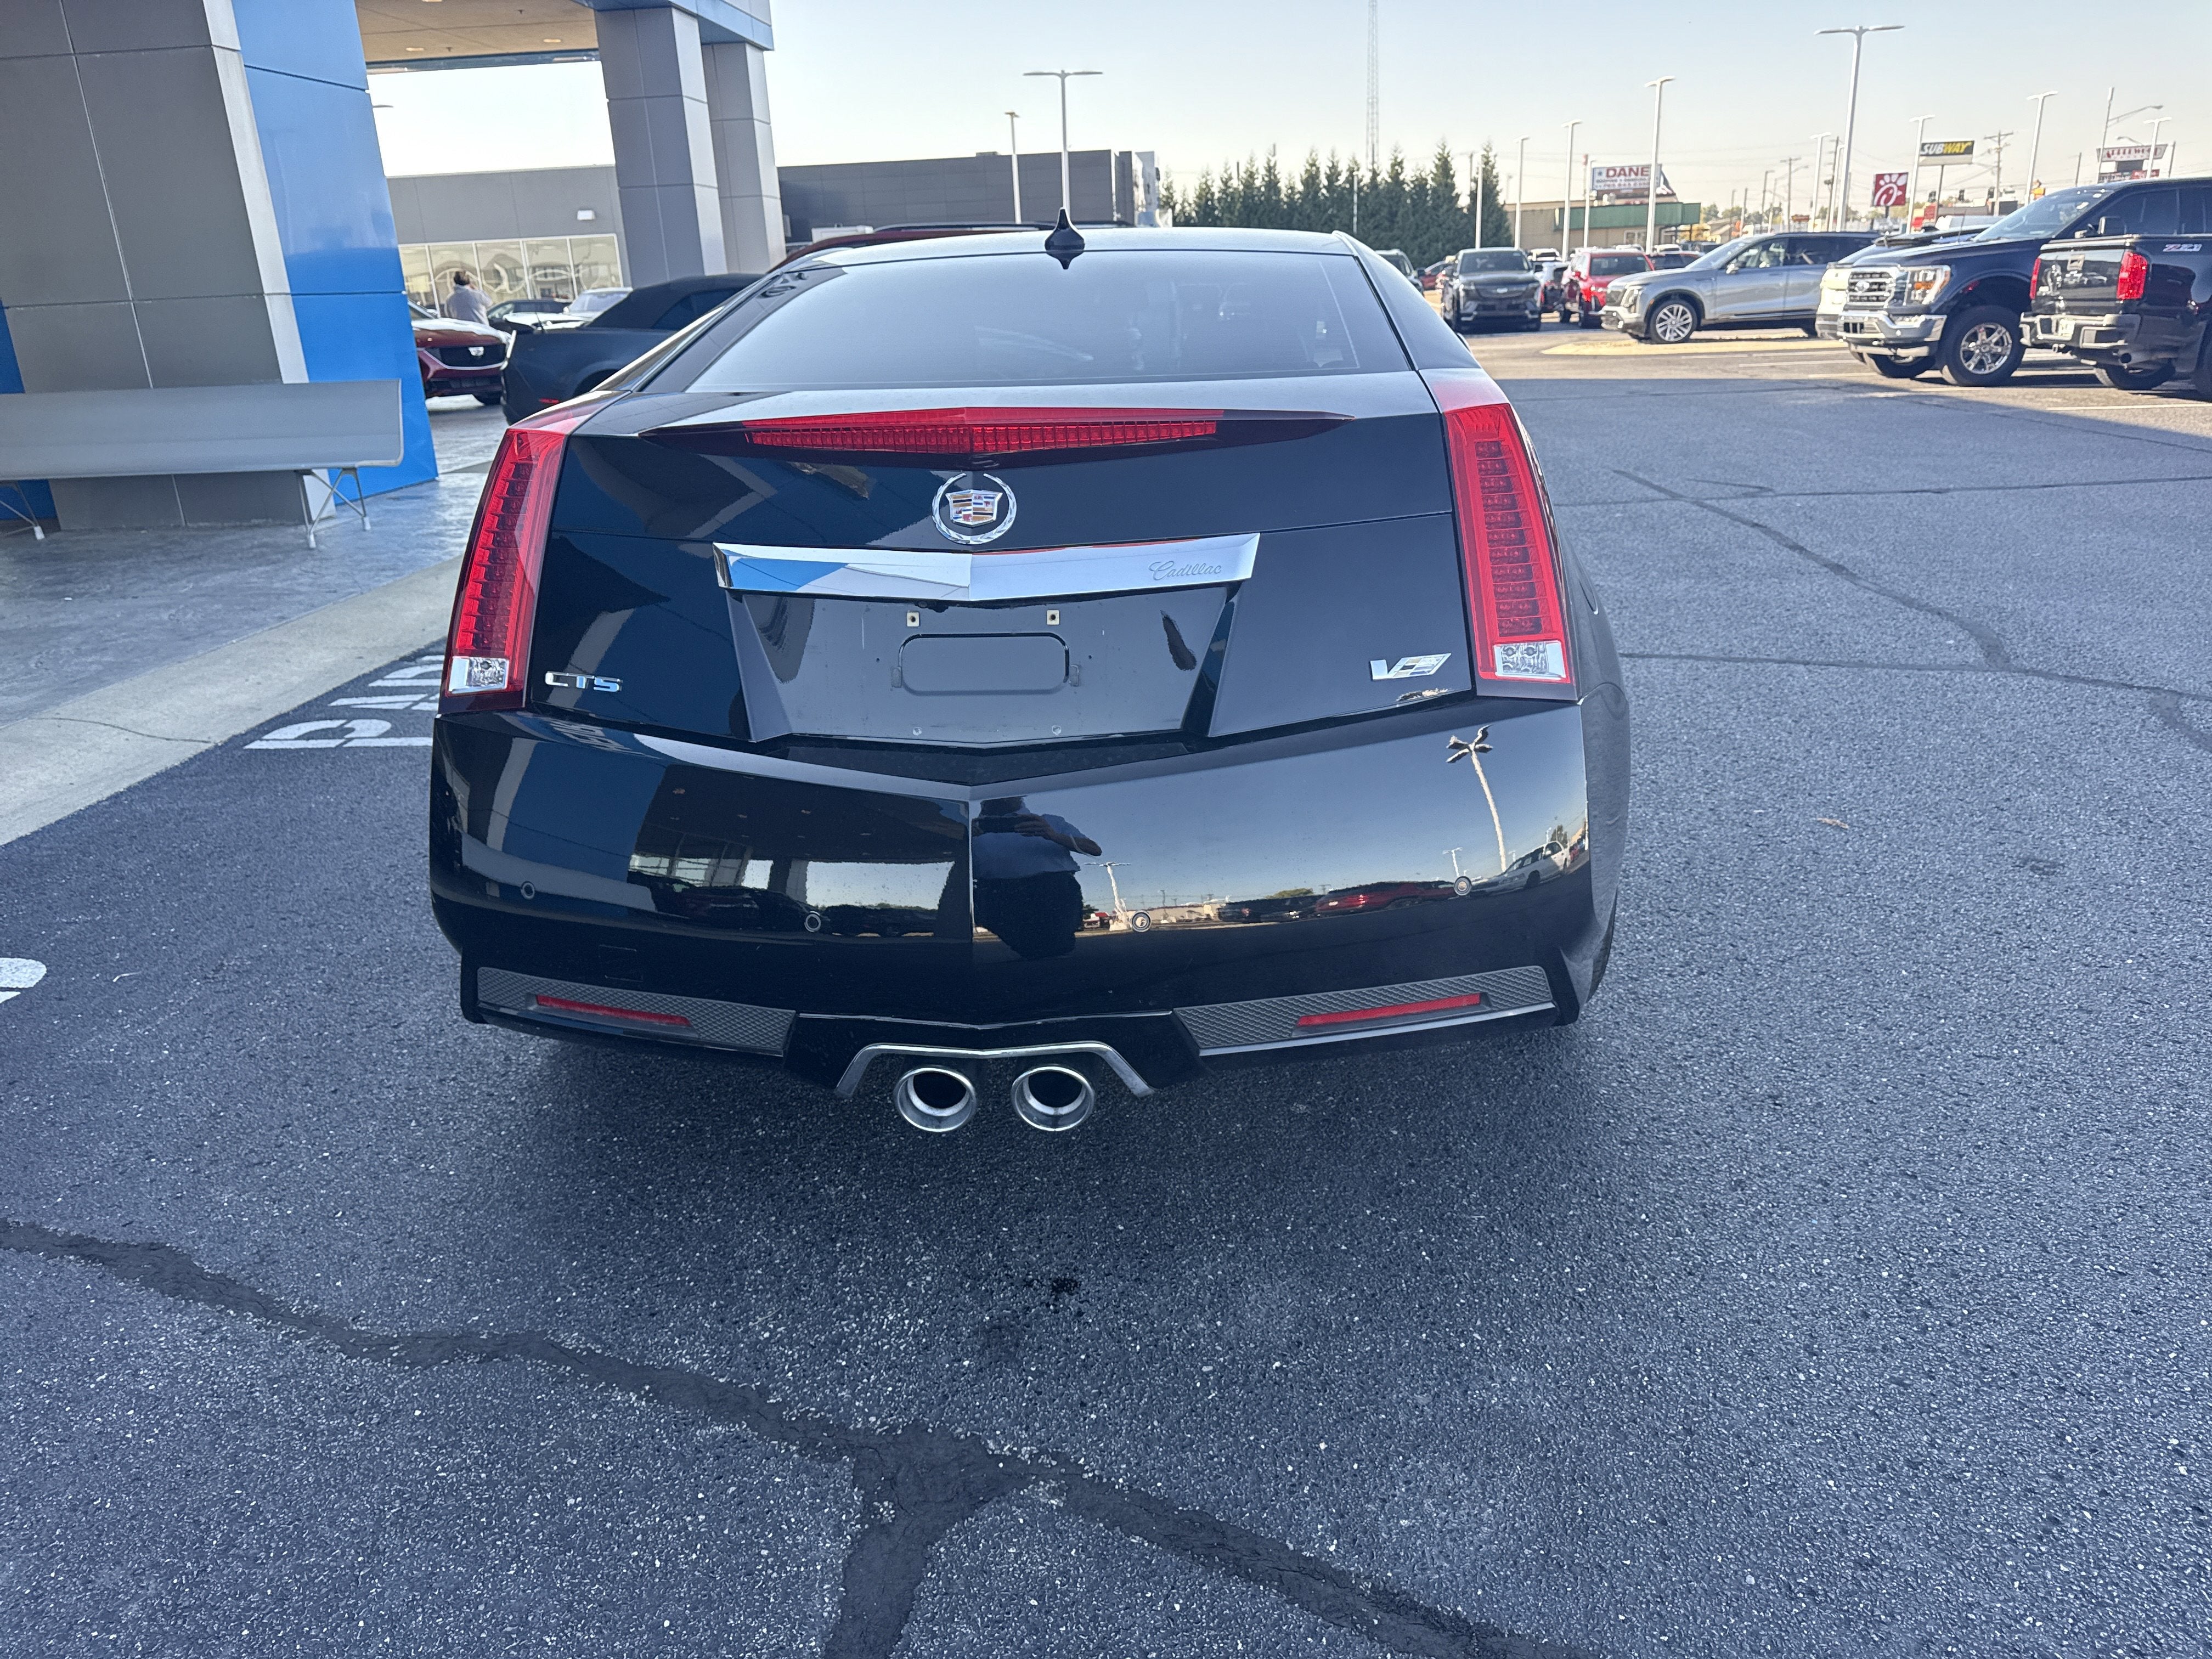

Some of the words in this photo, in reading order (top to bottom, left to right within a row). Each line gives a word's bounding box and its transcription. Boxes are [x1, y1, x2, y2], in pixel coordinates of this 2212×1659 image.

[1920, 142, 1972, 155] SUBWAY
[1606, 166, 1650, 178] DANE
[1148, 560, 1221, 581] Cadillac
[545, 671, 623, 692] CTS
